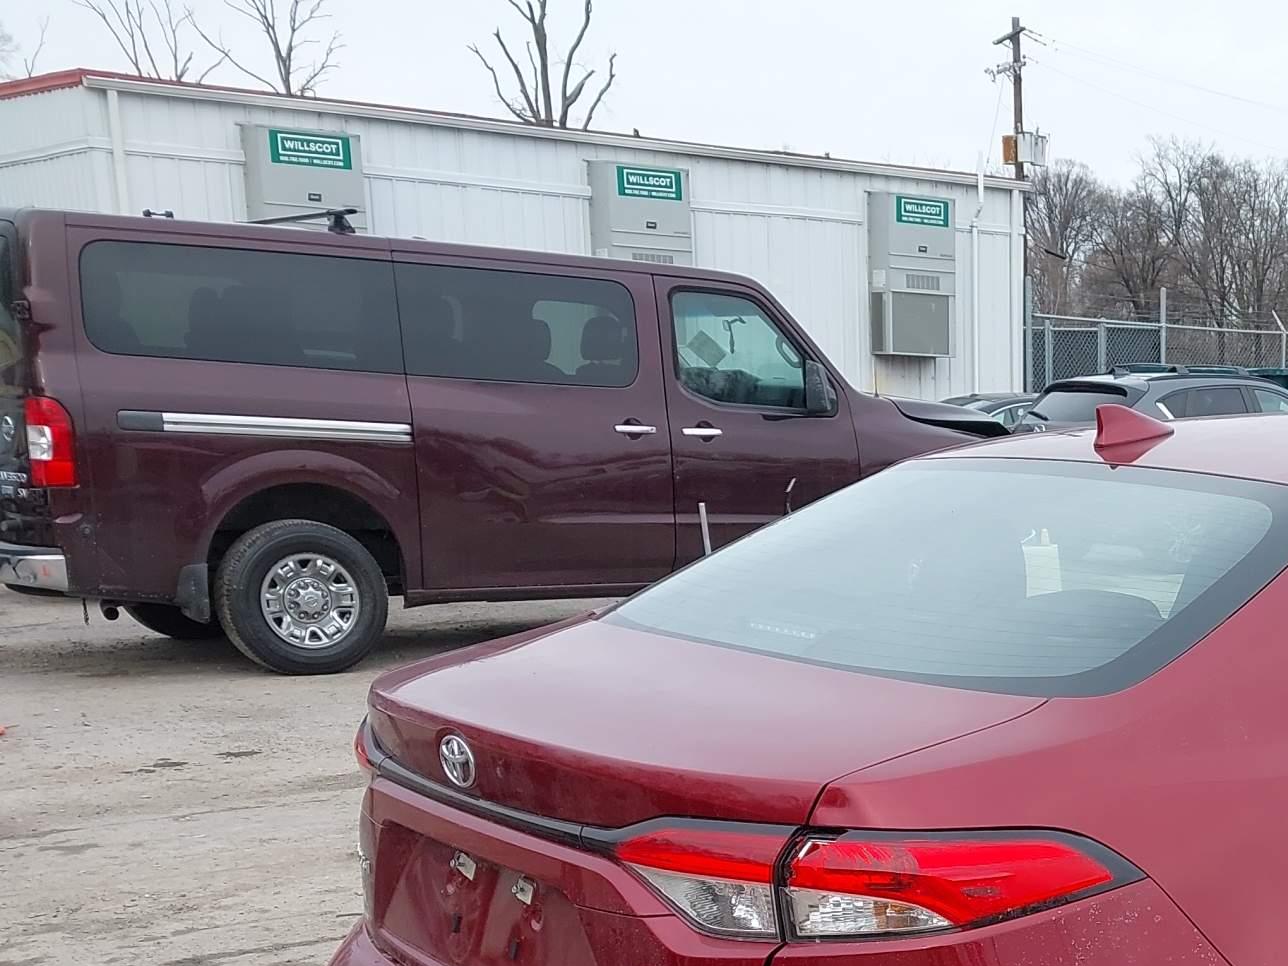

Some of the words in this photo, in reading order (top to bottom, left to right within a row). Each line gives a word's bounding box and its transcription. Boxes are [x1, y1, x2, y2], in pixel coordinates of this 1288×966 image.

[283, 139, 337, 154] WILLSCOT
[628, 174, 671, 187] WILLSCOT
[905, 203, 941, 215] WILLSCOT
